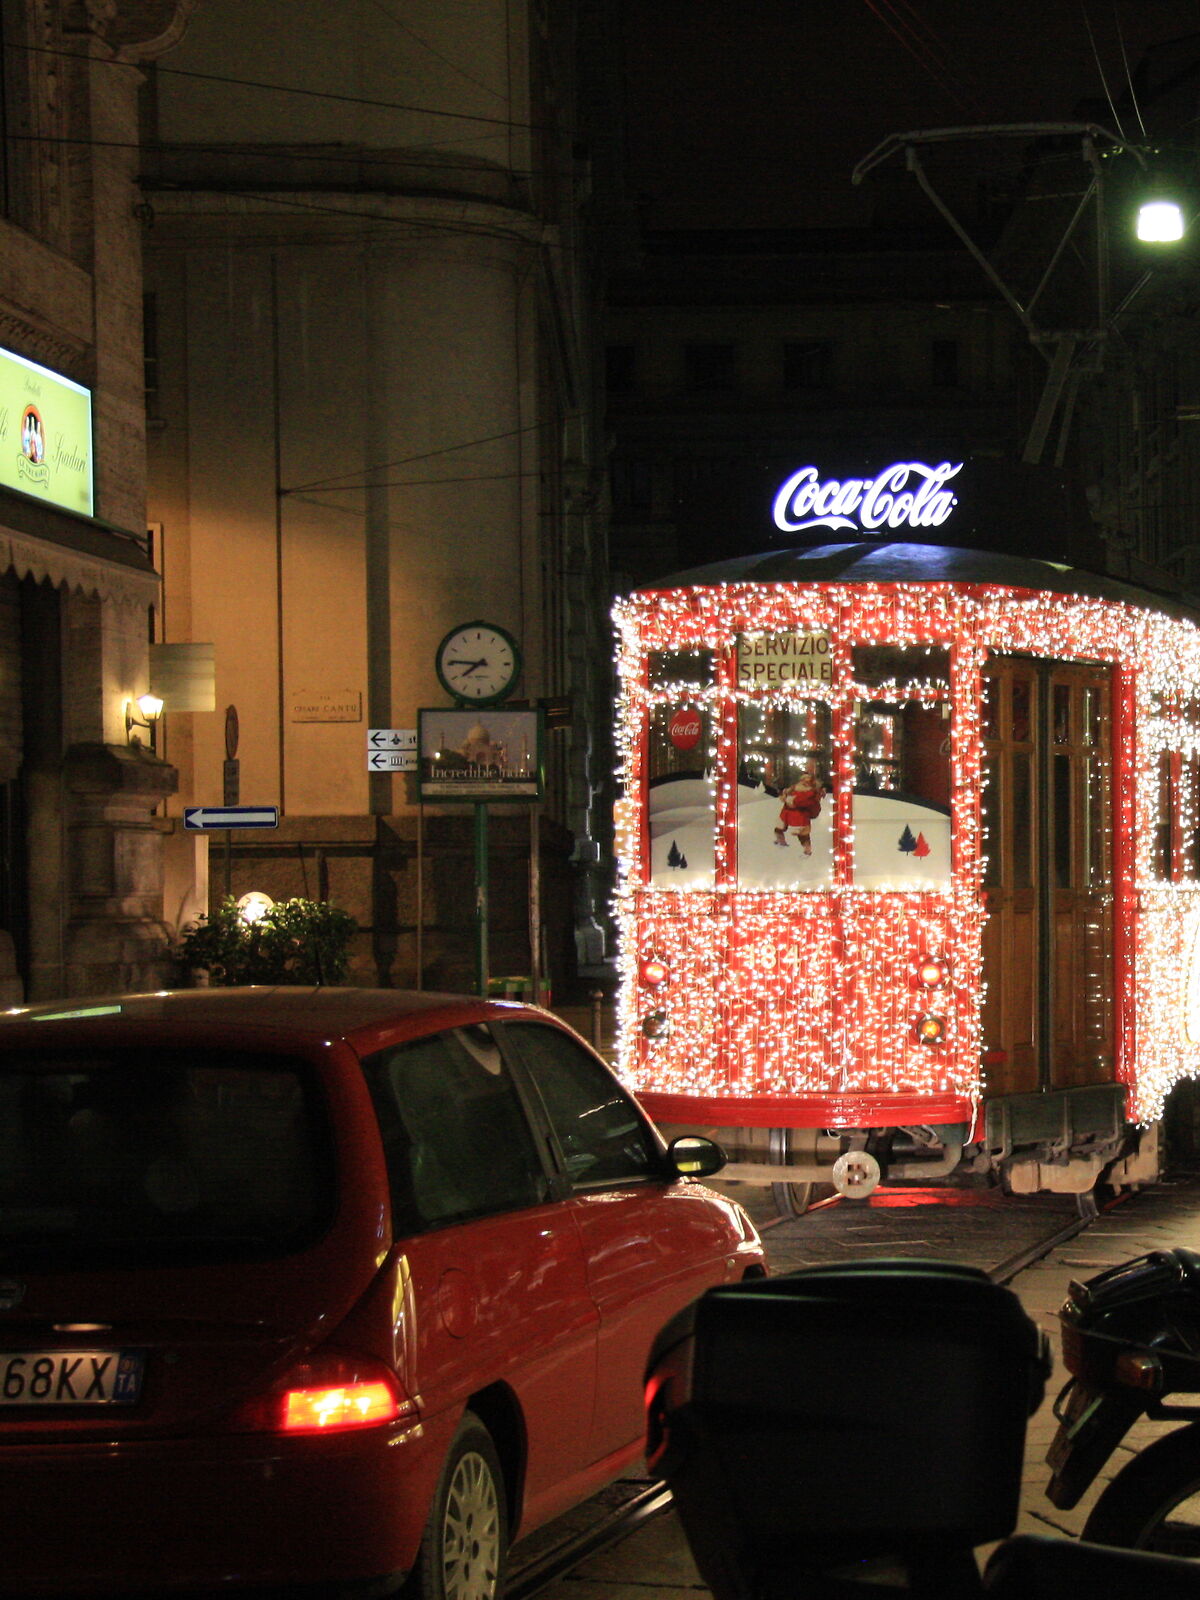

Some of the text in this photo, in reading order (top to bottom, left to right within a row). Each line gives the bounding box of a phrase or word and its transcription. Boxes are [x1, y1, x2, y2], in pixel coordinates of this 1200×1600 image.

[773, 461, 965, 533] Coca-Cola
[741, 637, 830, 656] SERVIZIO
[739, 661, 833, 681] SPECIALE
[671, 722, 700, 736] Coca-Cola
[431, 764, 497, 779] Incredible
[2, 1356, 113, 1400] 68KX
